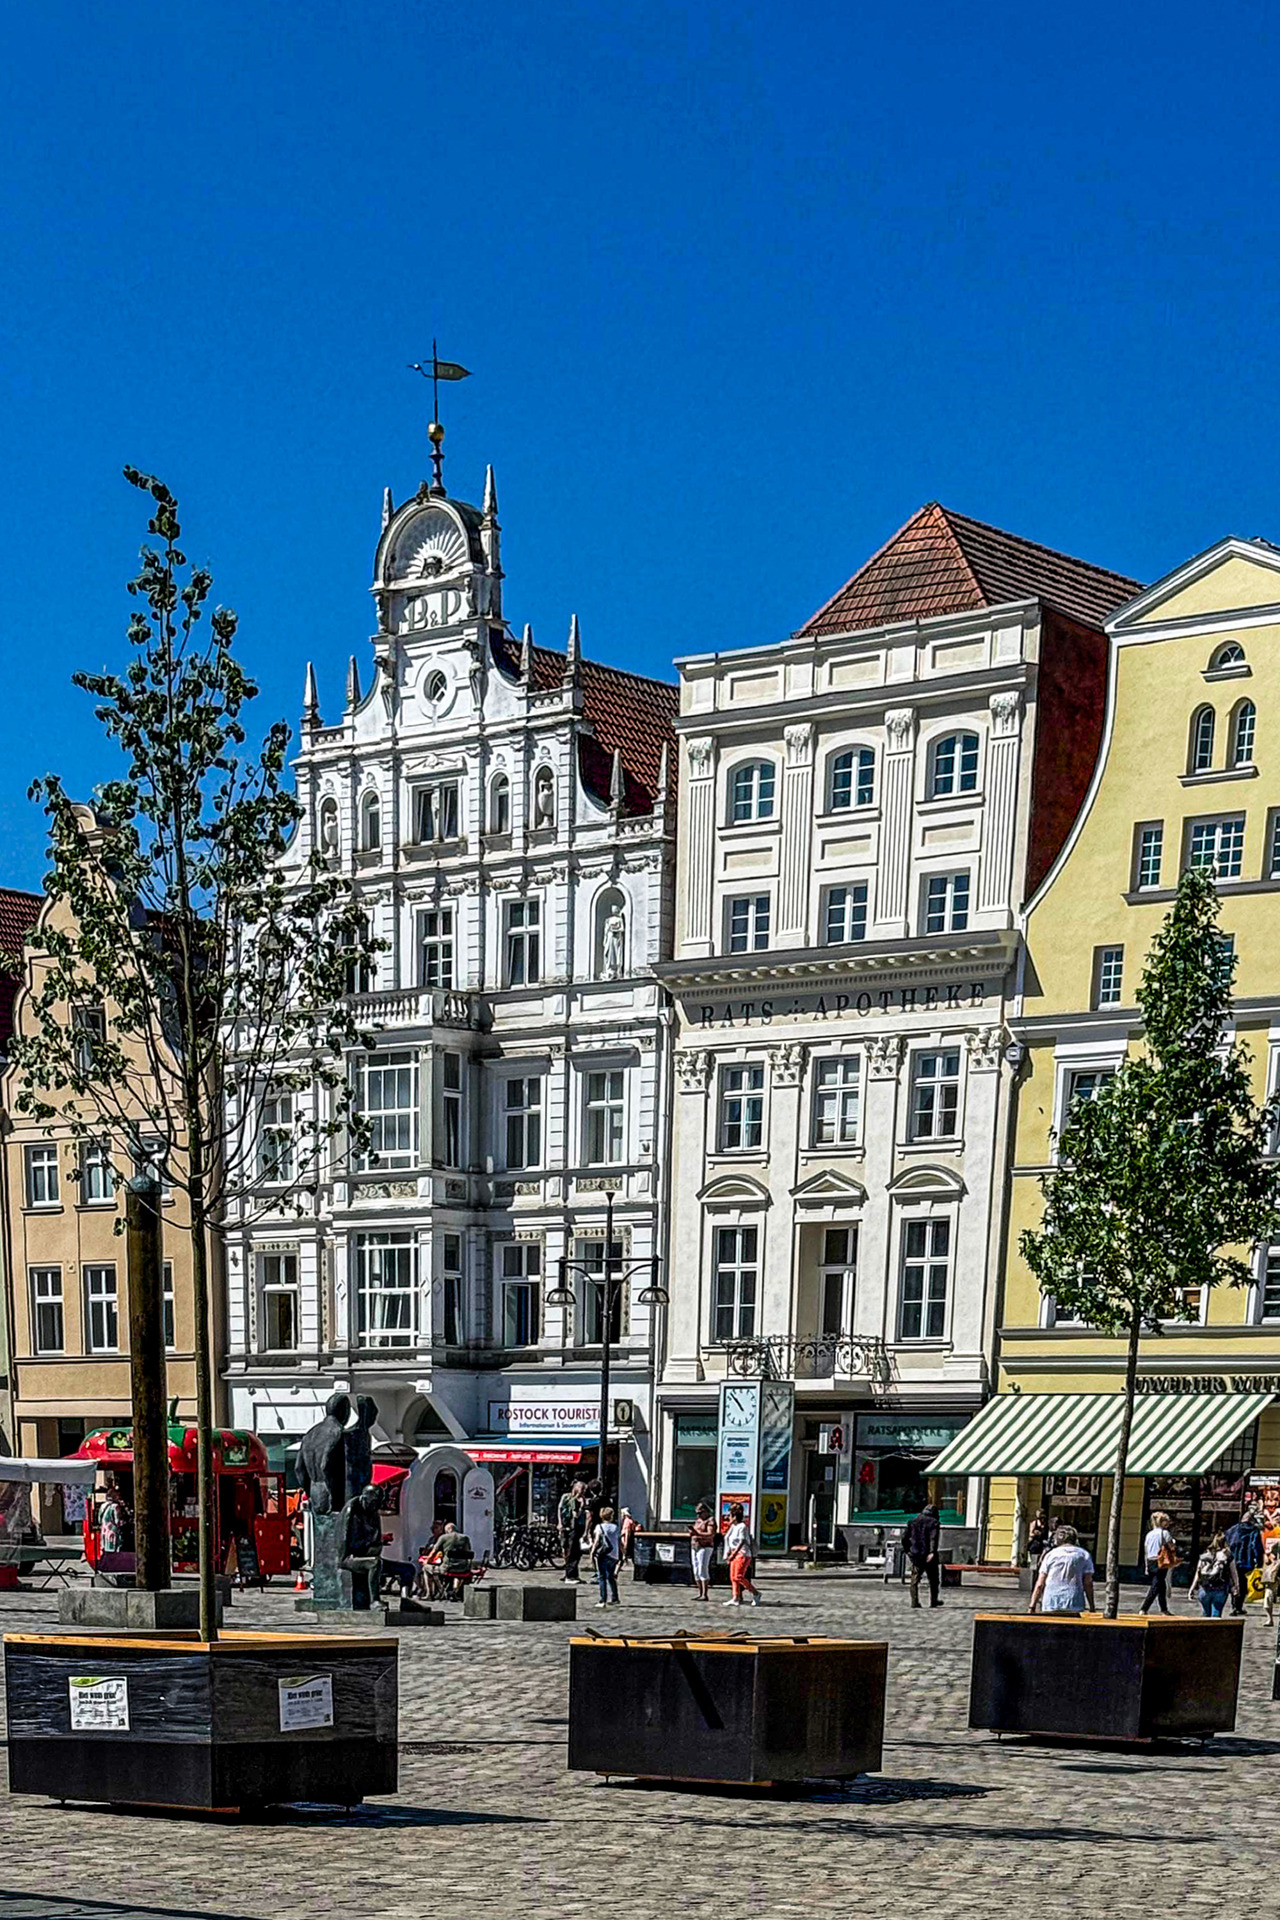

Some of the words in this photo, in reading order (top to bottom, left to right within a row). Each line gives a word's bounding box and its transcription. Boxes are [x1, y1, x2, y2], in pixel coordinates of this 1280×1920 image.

[700, 1001, 774, 1030] RATS
[812, 982, 985, 1021] APOTHEKE
[1121, 1375, 1228, 1393] UWELIER
[498, 1408, 549, 1420] ROSTOCK
